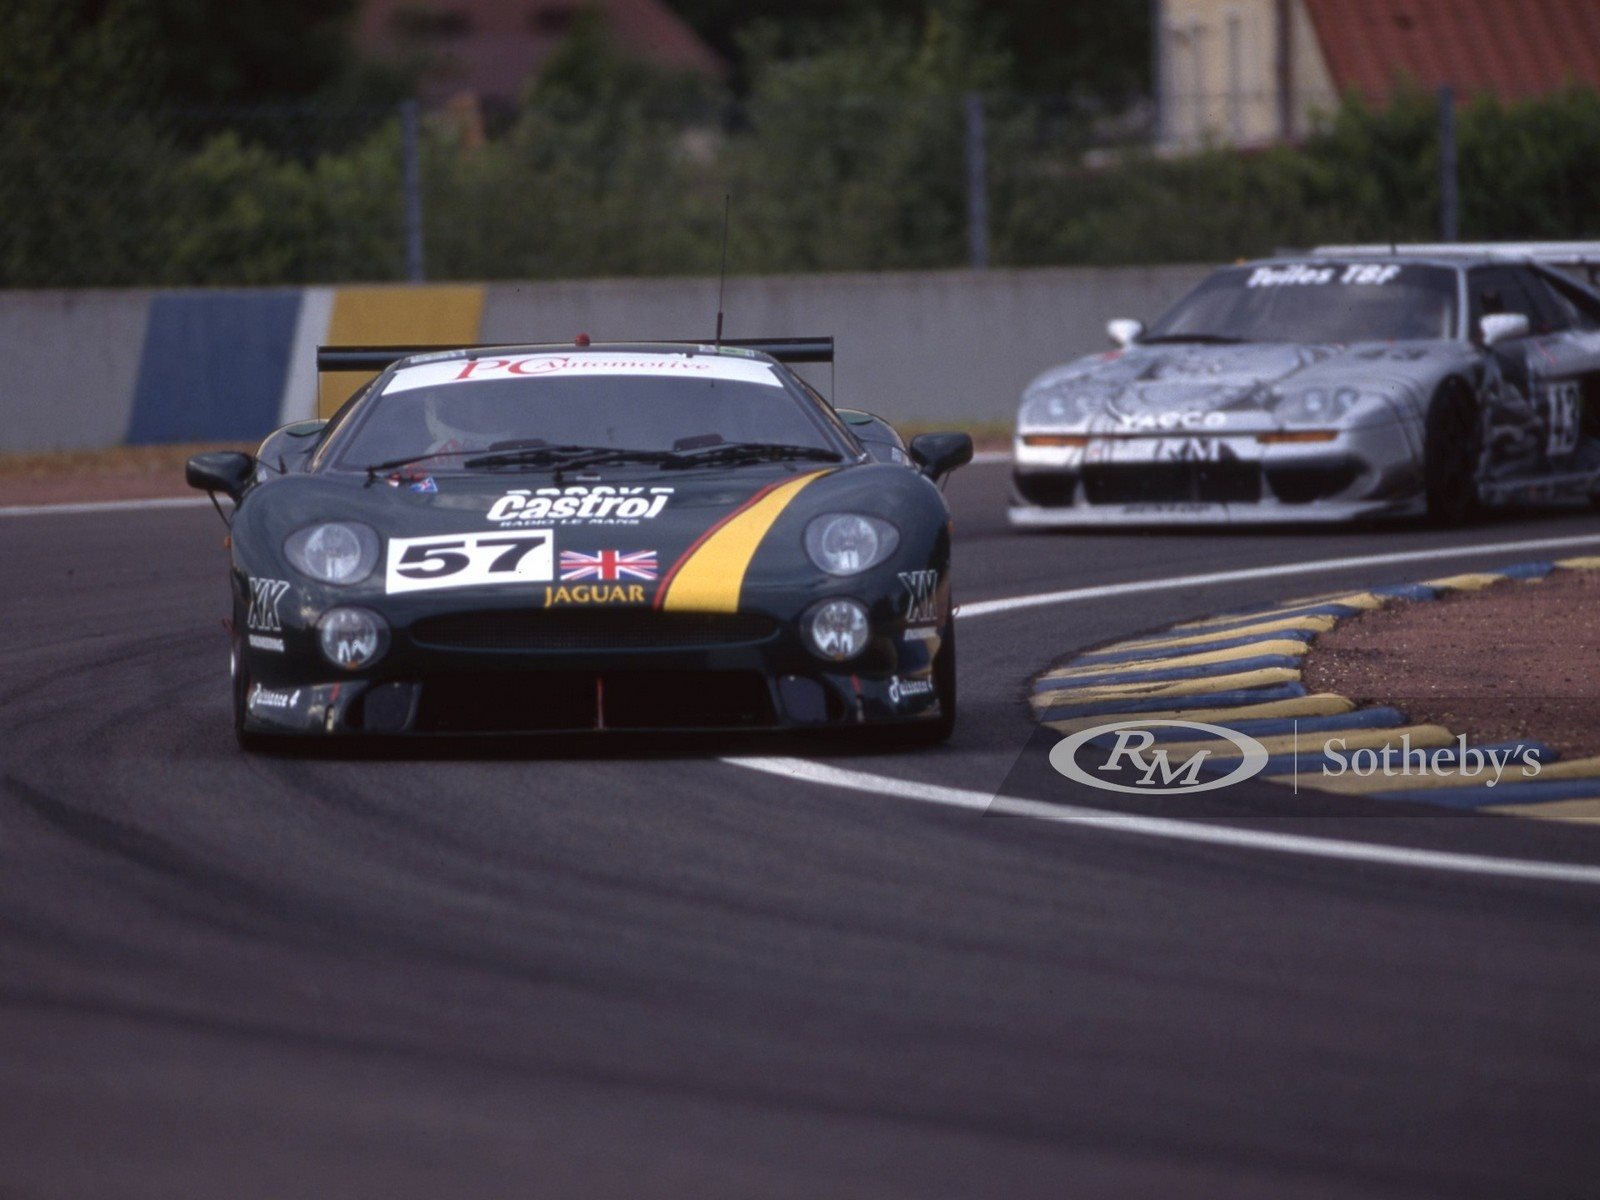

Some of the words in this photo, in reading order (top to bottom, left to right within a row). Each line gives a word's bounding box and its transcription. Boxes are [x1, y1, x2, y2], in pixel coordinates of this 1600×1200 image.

[454, 356, 571, 380] PC
[534, 359, 711, 370] Automotive
[486, 492, 669, 521] Castrol
[500, 518, 556, 528] RADIO
[396, 537, 546, 579] 57
[544, 585, 645, 607] JAGUAR
